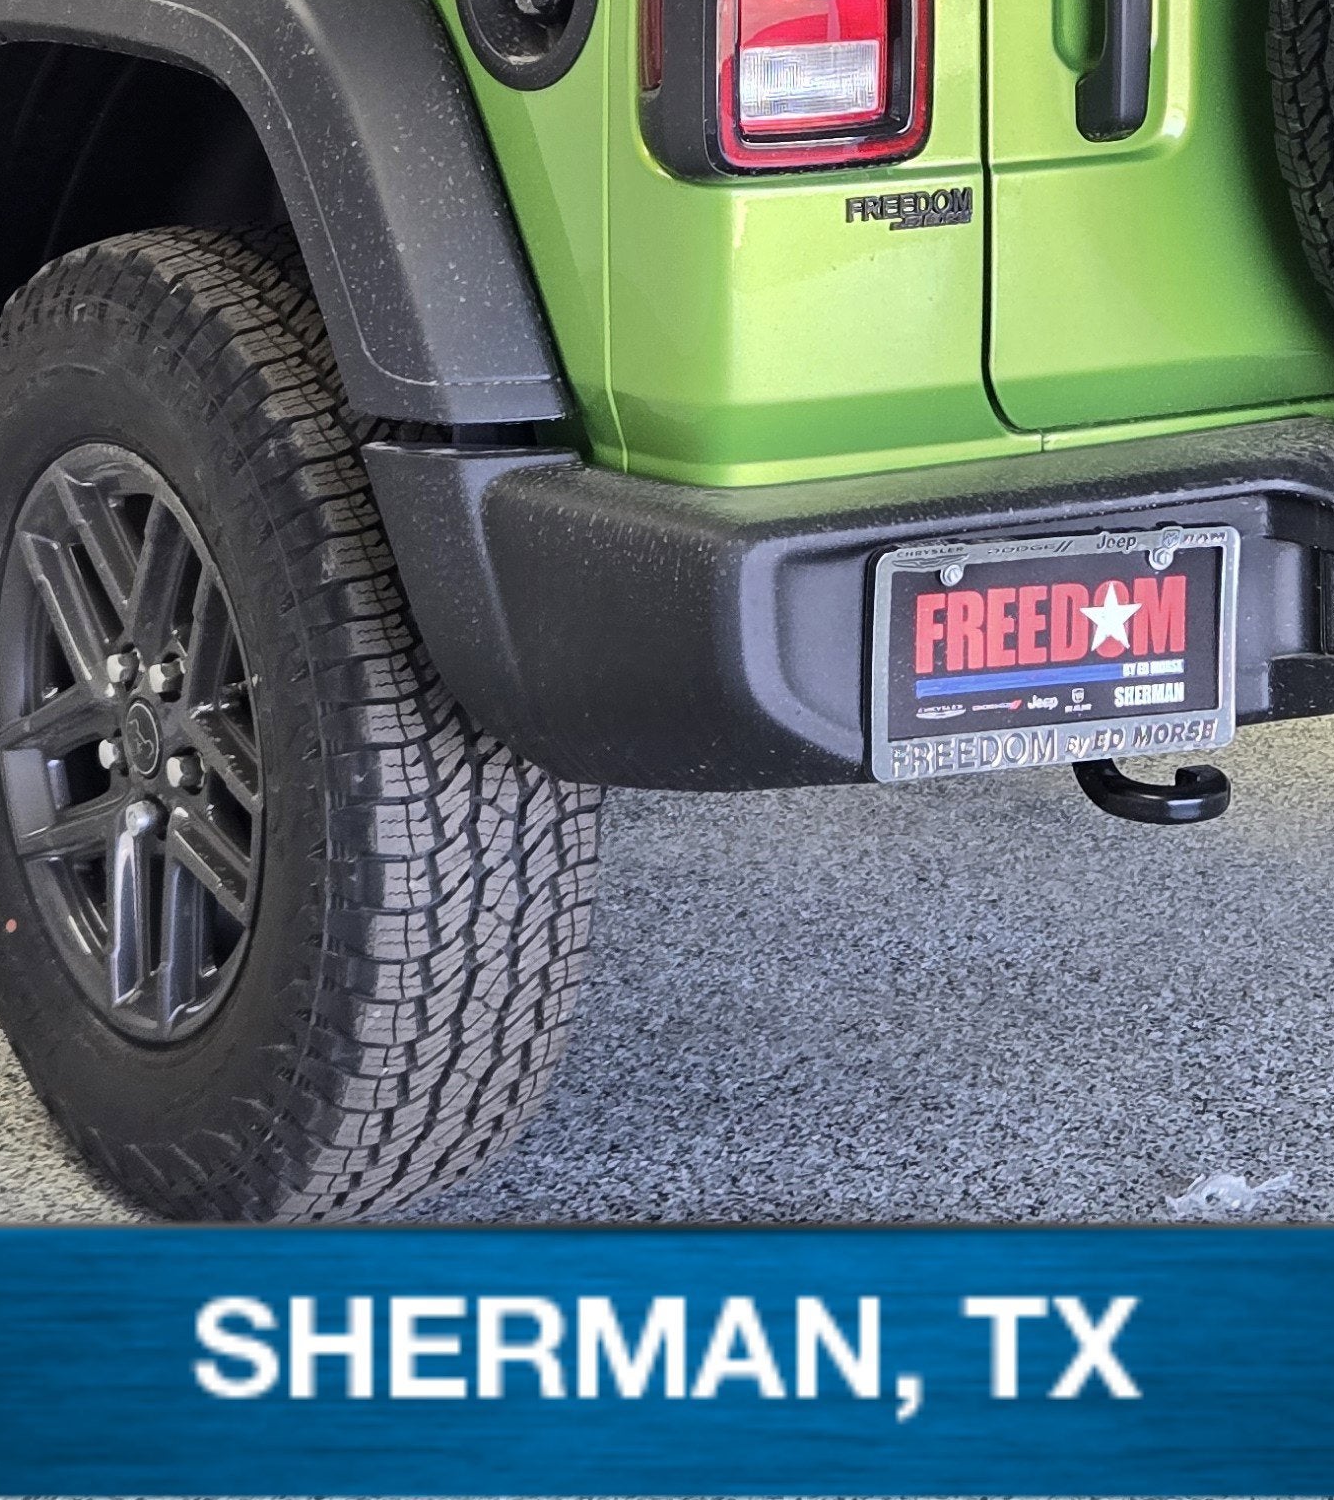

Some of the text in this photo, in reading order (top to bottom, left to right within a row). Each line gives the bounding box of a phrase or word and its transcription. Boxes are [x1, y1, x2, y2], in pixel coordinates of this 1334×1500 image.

[845, 187, 973, 223] FREEDOM
[896, 545, 965, 559] CHRYSLER
[1096, 533, 1138, 552] Jeep
[1113, 681, 1186, 708] SHERMAN
[889, 729, 1059, 778] FREEDOM
[1093, 728, 1127, 752] ED
[1132, 718, 1219, 749] MORSE
